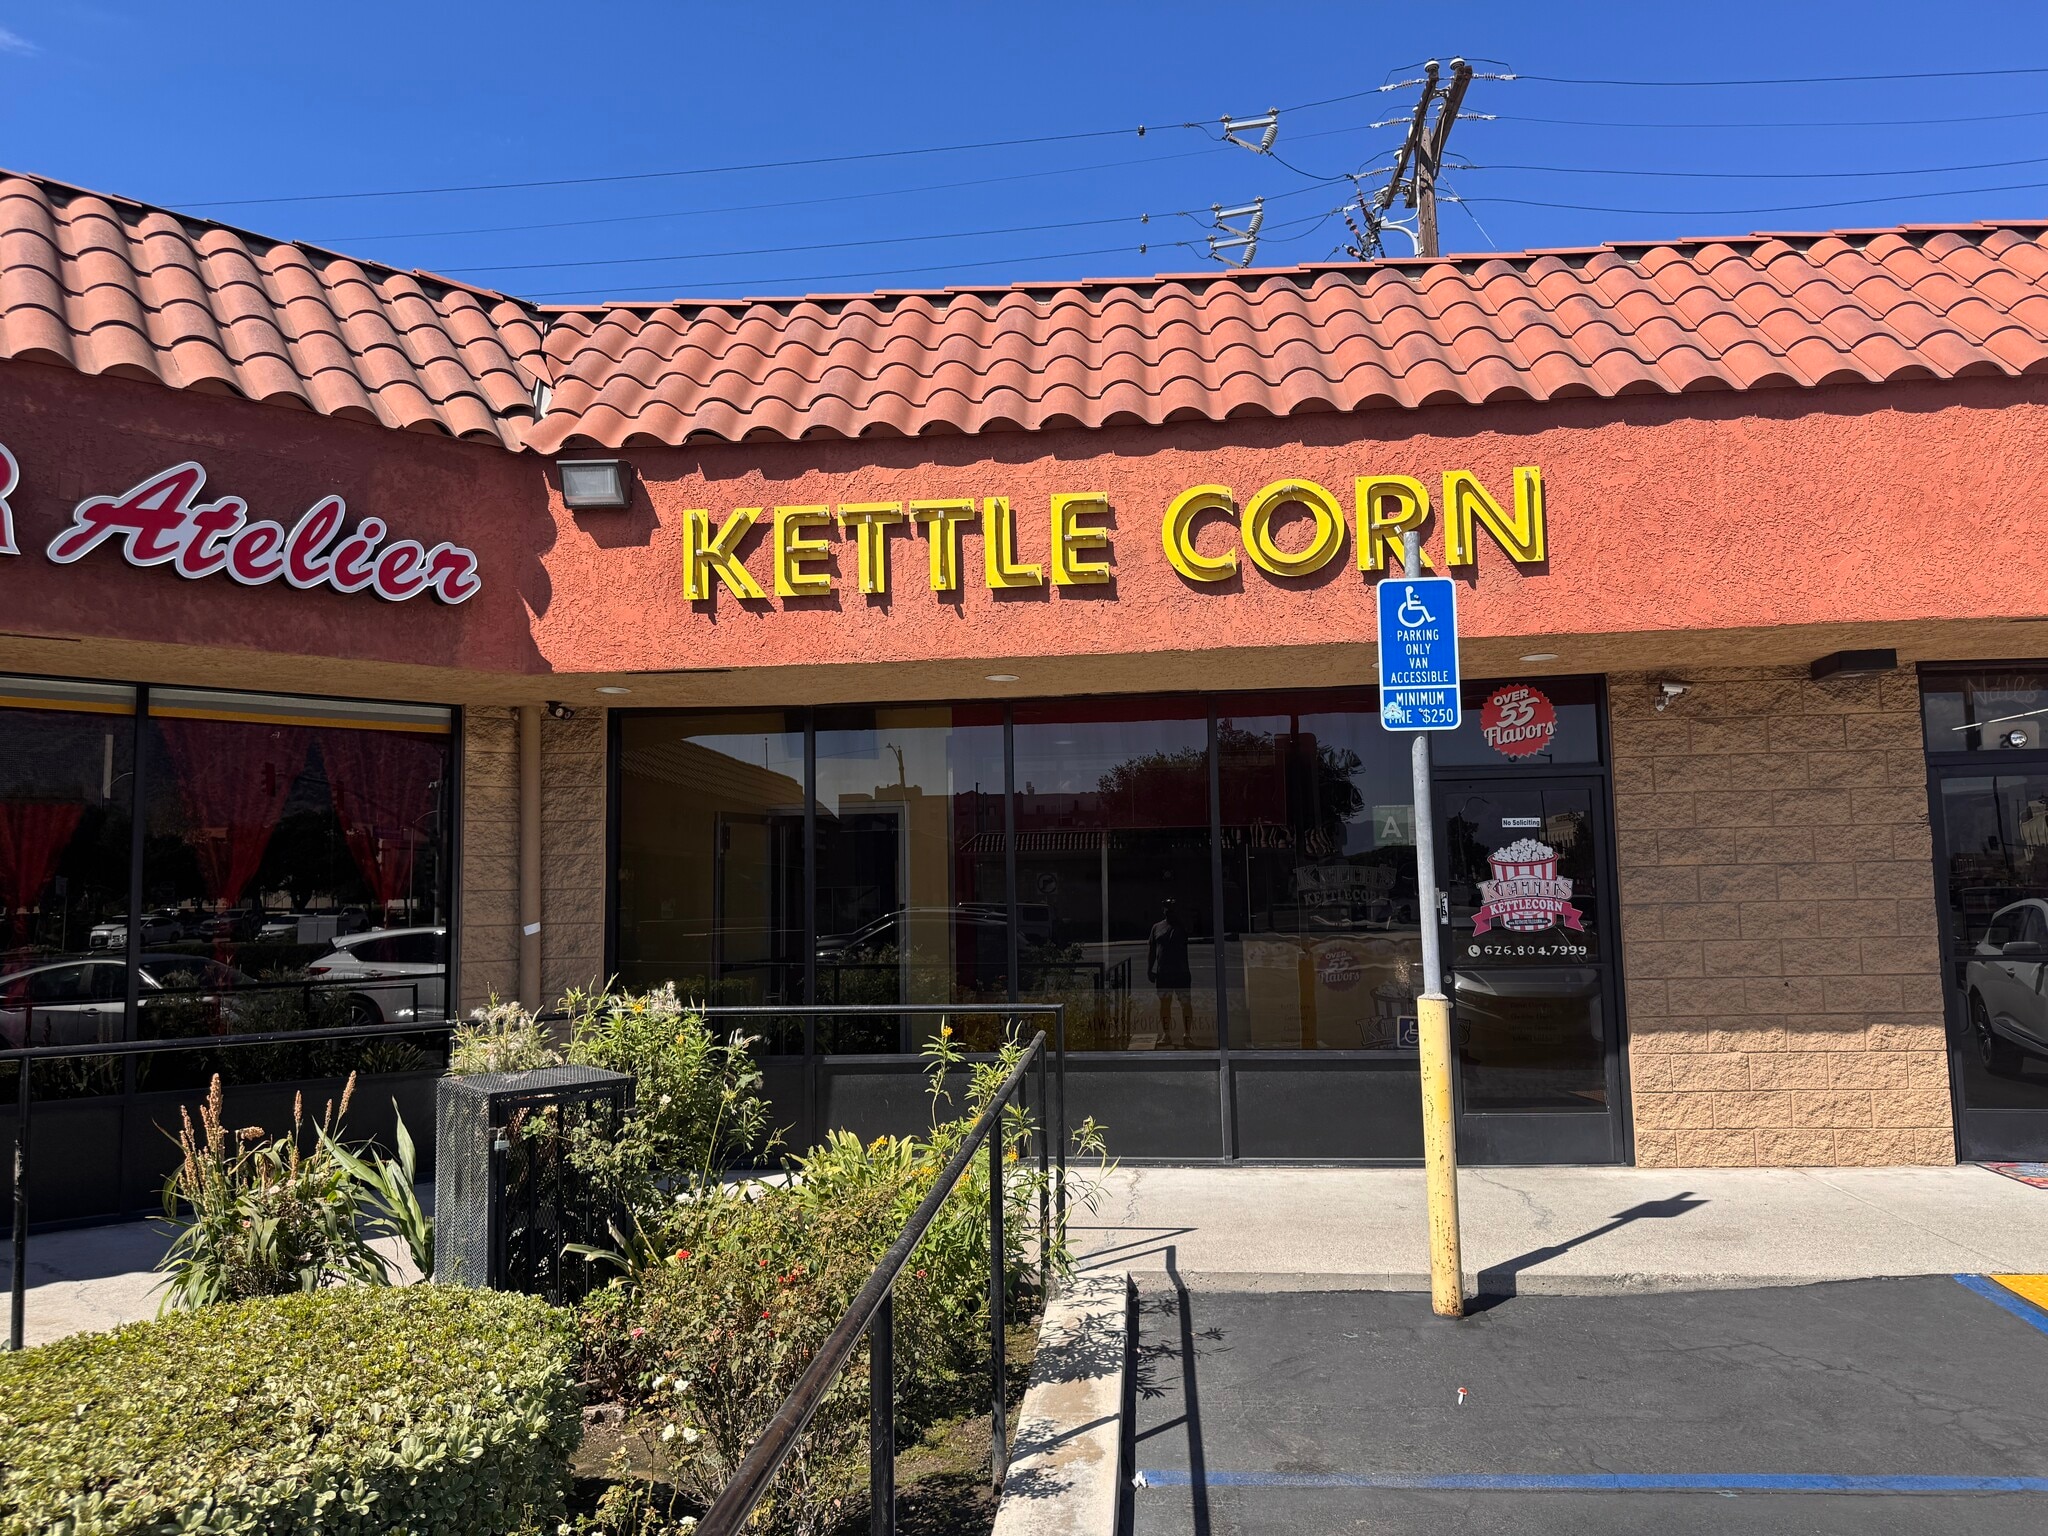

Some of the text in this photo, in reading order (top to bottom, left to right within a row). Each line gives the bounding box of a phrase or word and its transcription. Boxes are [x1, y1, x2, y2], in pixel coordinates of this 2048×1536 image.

[47, 461, 481, 605] Atelier
[683, 466, 1545, 600] KETTLE CORN
[1397, 629, 1439, 641] PARKING
[1405, 643, 1431, 655] ONLY
[1409, 657, 1428, 669] VAN
[1391, 671, 1449, 684] ACCESSIBLE
[1967, 672, 2039, 705] Nails
[1396, 691, 1444, 706] MINIMUM
[1493, 688, 1529, 706] OVER
[1389, 708, 1454, 724] NE $250
[1496, 697, 1540, 728] 55
[1484, 721, 1554, 747] Flavors
[1381, 816, 1402, 838] A
[1512, 819, 1540, 827] Soliciting
[1476, 875, 1573, 905] KEITH'S
[1489, 899, 1563, 916] KETTLECORN
[1325, 950, 1347, 960] OVER
[1484, 945, 1587, 956] 626.804.7999
[1134, 1016, 1177, 1030] POPPED
[1185, 1016, 1218, 1030] FRESH
